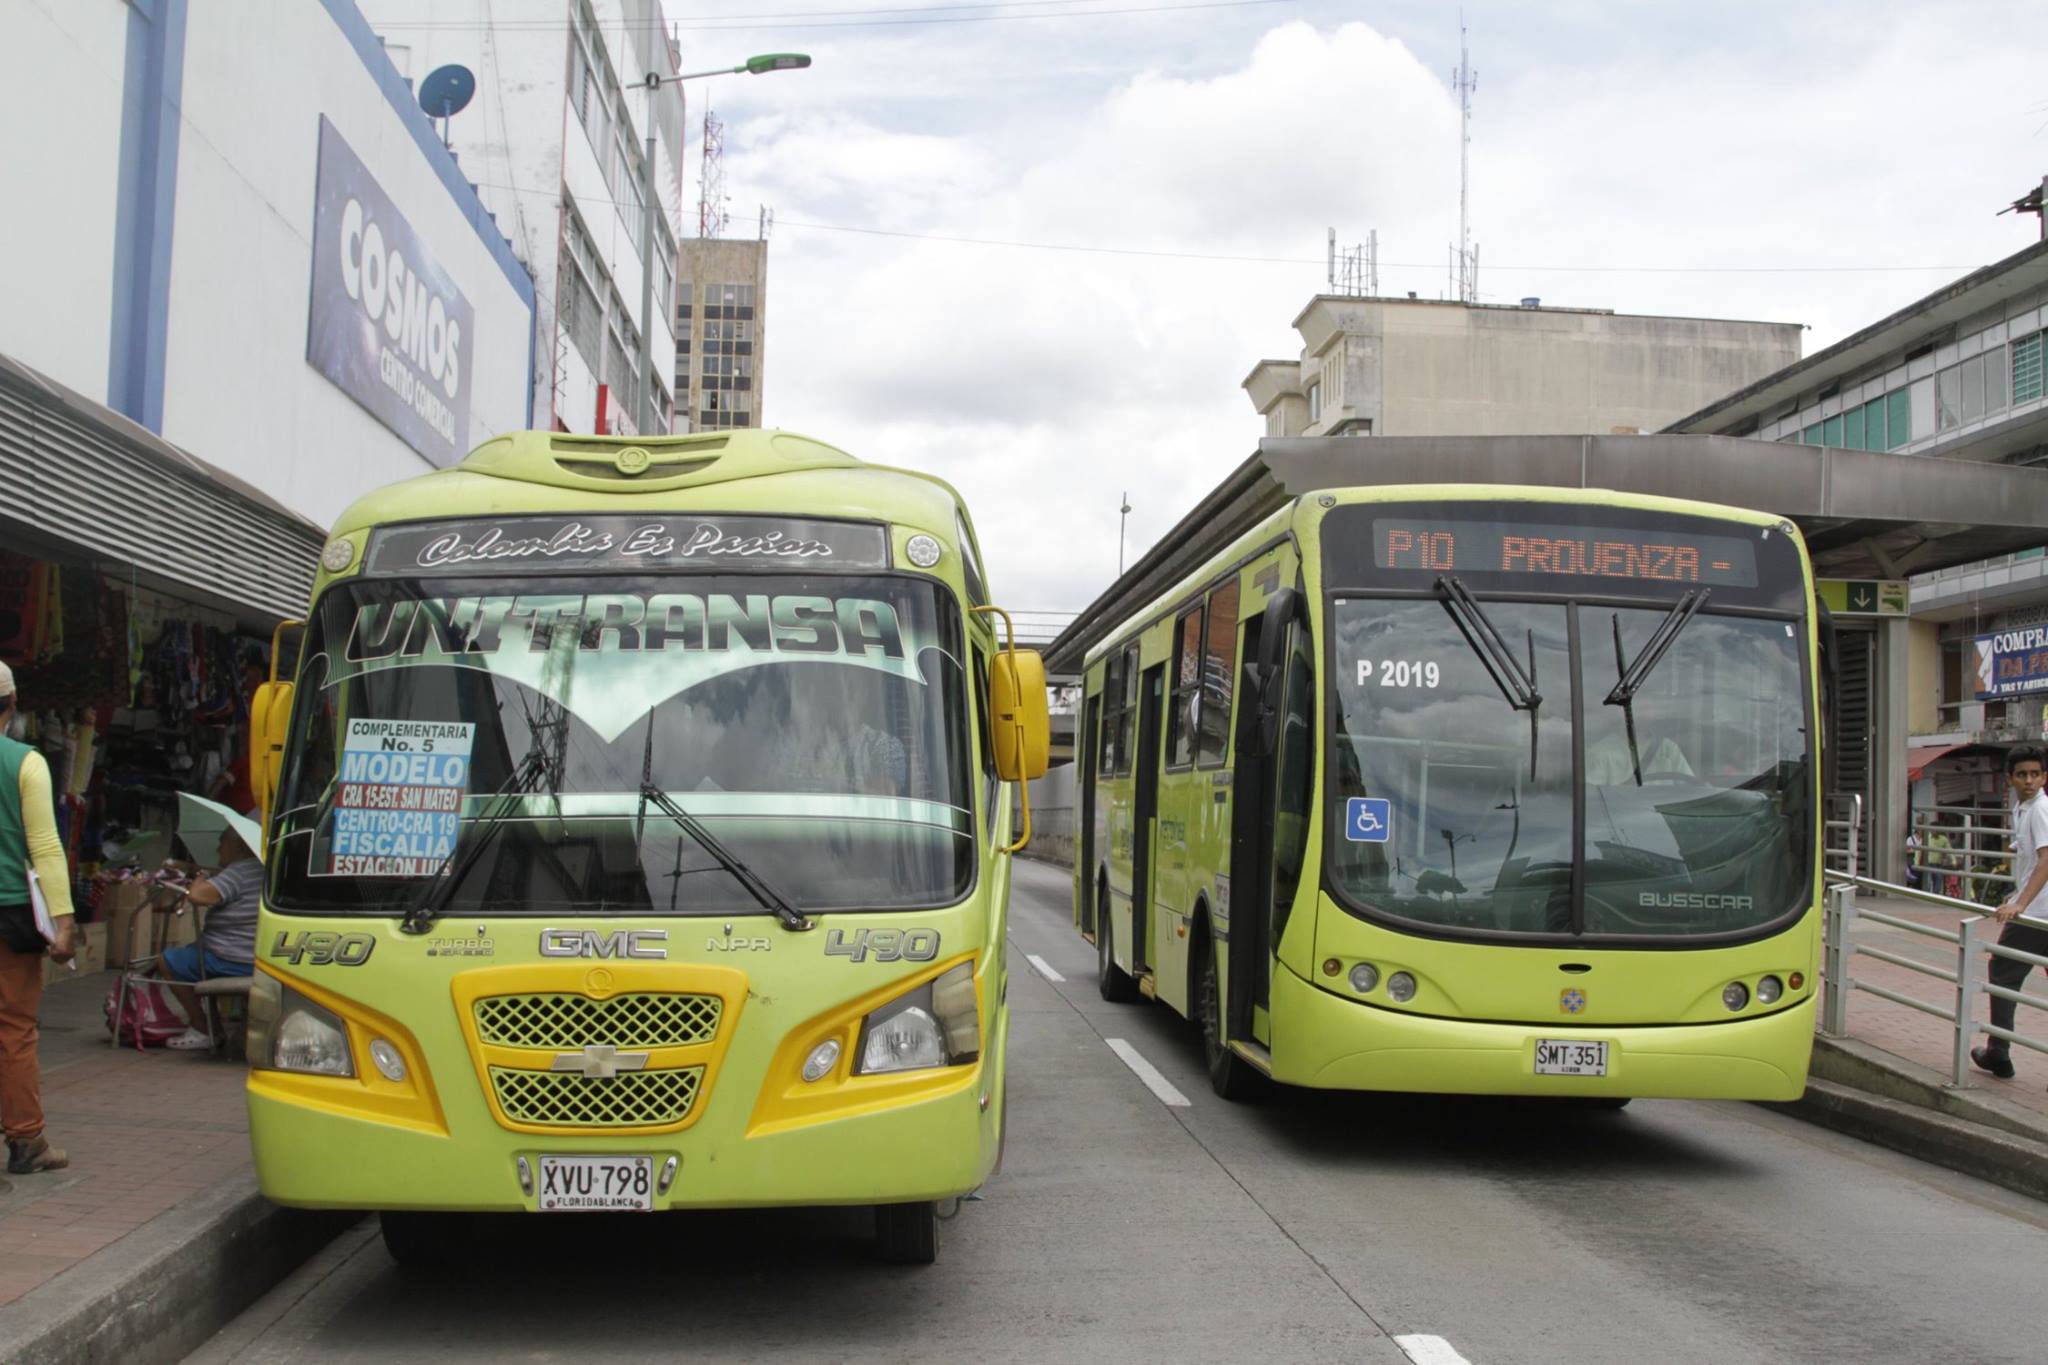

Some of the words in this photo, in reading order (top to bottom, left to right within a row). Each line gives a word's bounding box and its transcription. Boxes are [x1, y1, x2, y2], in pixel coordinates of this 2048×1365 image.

[341, 198, 460, 398] COSMOS
[619, 524, 674, 555] Es
[1387, 530, 1454, 570] P10
[345, 595, 904, 662] UNITRANSA
[1993, 628, 2048, 653] COMPR
[1357, 660, 1372, 686] P
[1380, 660, 1440, 688] 2019
[352, 722, 468, 739] COMPLEMENTARIA
[381, 737, 414, 752] No.
[422, 739, 434, 753] 5
[343, 753, 464, 785] MODELO
[342, 784, 363, 807] CRA
[400, 787, 423, 810] SAN
[423, 788, 458, 811] MATEO
[438, 813, 456, 836] 19
[334, 832, 451, 858] FISCALIA
[1639, 892, 1753, 909] BUSSCAR
[271, 930, 376, 965] 490
[427, 938, 494, 948] TURBO
[538, 928, 669, 959] GMC
[706, 937, 771, 951] NPR
[824, 928, 941, 962] 490
[557, 1197, 635, 1207] FLORIDABLANCA
